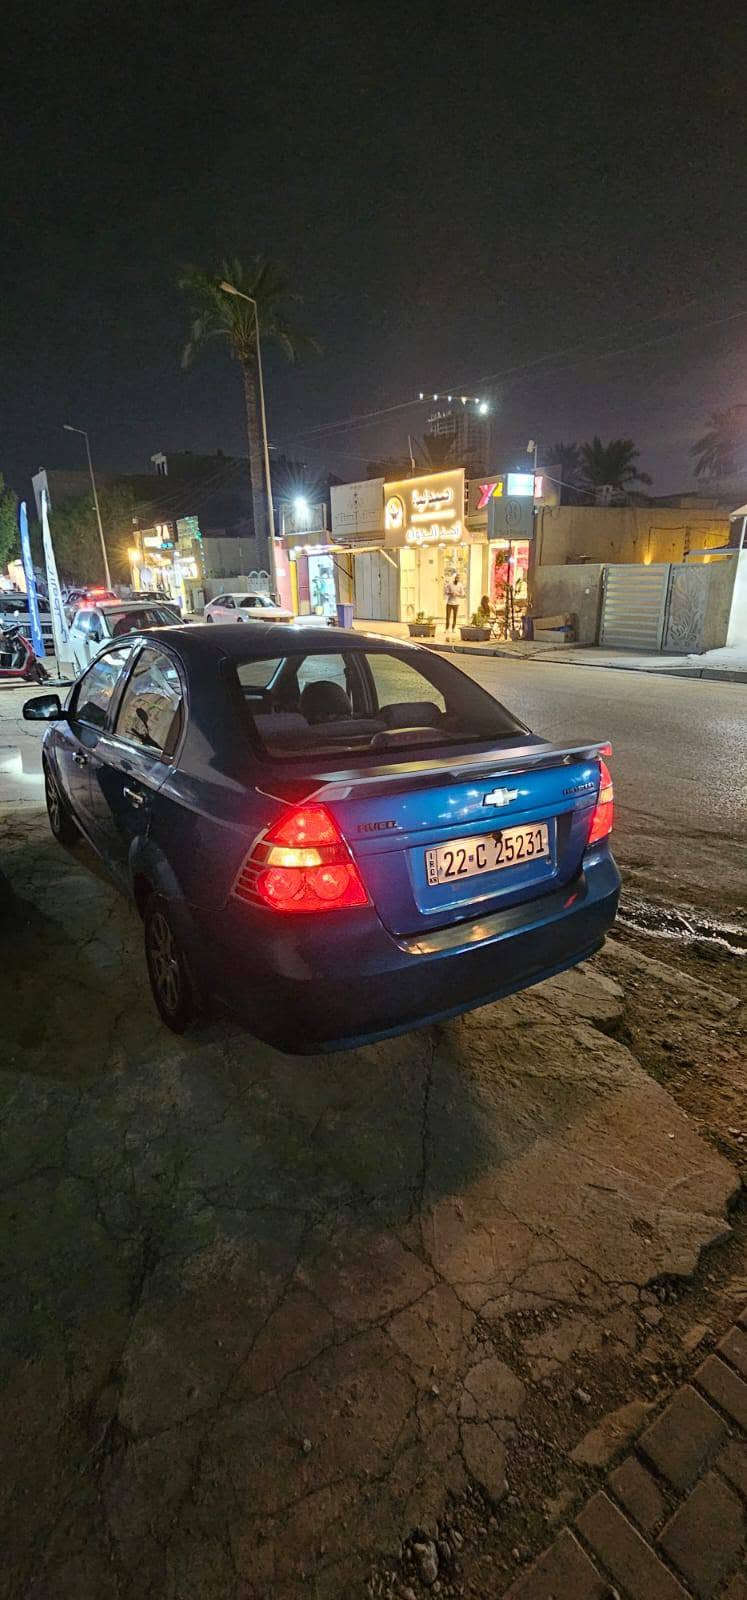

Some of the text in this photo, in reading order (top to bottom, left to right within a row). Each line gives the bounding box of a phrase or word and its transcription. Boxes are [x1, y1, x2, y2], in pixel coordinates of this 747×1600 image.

[443, 829, 545, 877] 22 C 25231
